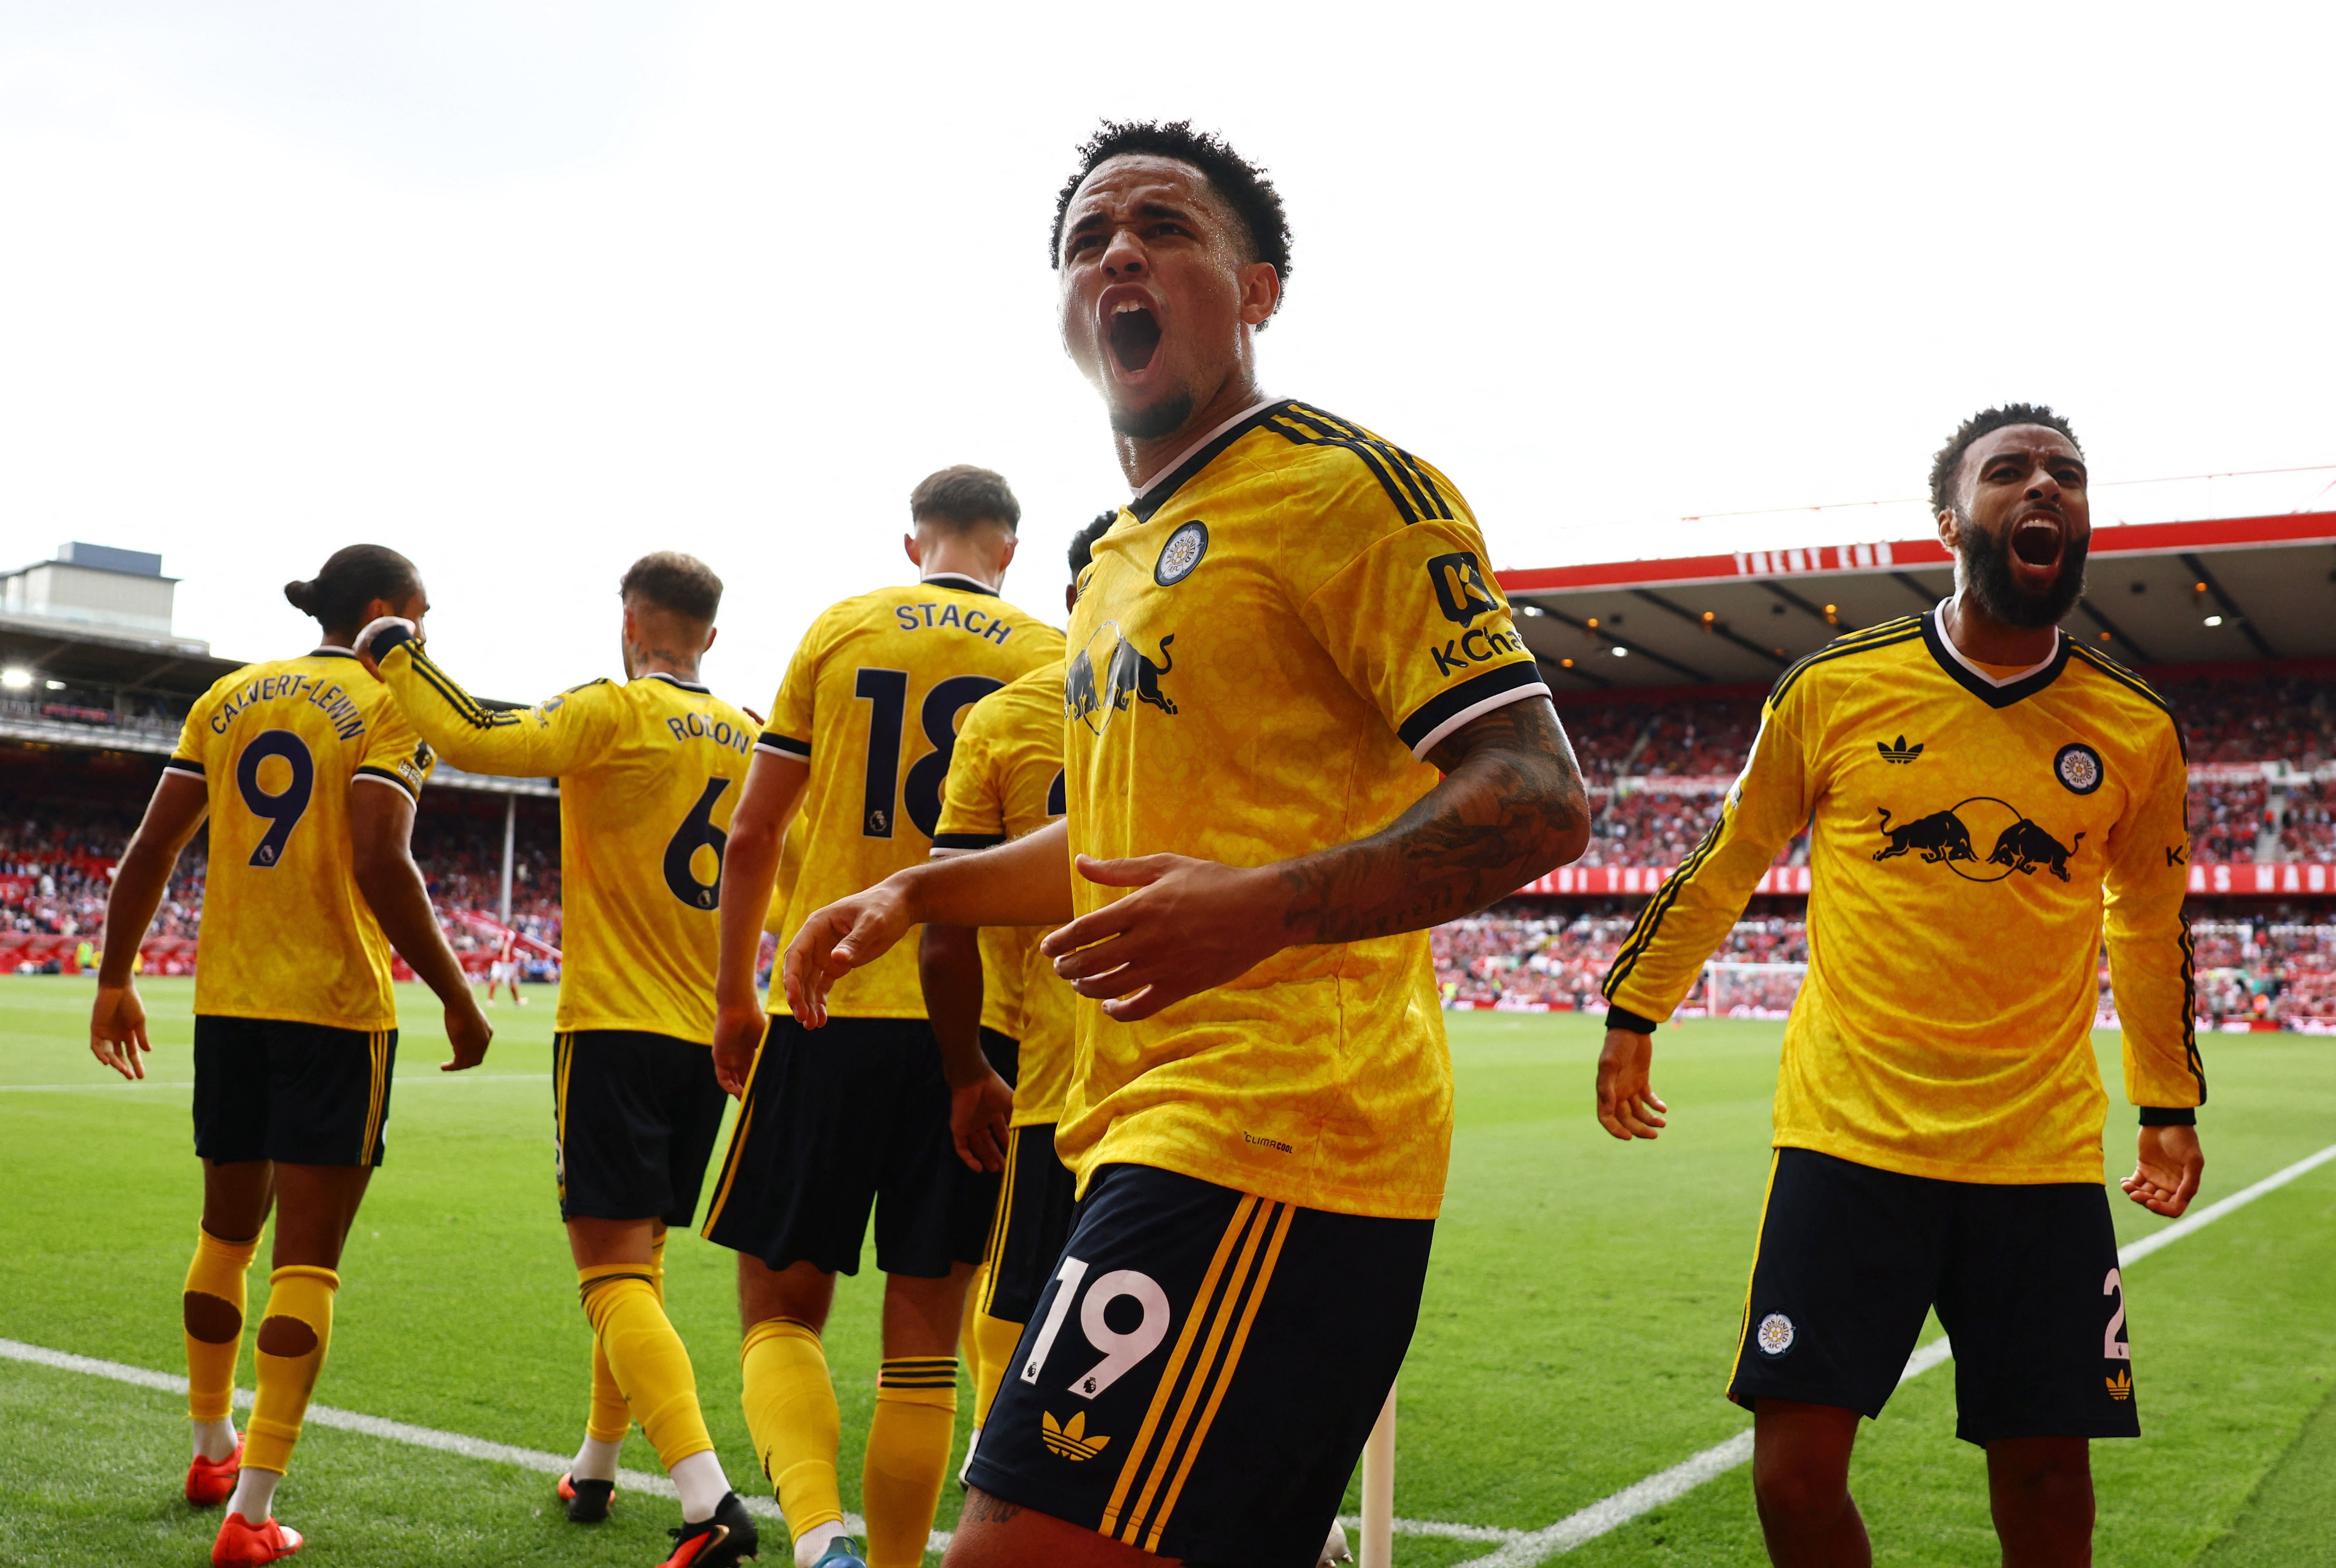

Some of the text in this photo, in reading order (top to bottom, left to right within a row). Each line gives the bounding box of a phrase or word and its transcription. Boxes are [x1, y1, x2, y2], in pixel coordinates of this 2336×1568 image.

[1166, 536, 1196, 564] LEEDS UNITED
[895, 602, 1012, 646] STACH
[210, 674, 366, 741] CALVERT-LEWIN
[854, 666, 1008, 840] 18
[2065, 754, 2093, 779] LEEDS UNITED
[236, 728, 315, 868] 9
[663, 776, 732, 911] 6
[1019, 1255, 1170, 1399] 19
[1762, 1319, 1789, 1342] LEEDS UNITED
[2104, 1268, 2130, 1359] 2
